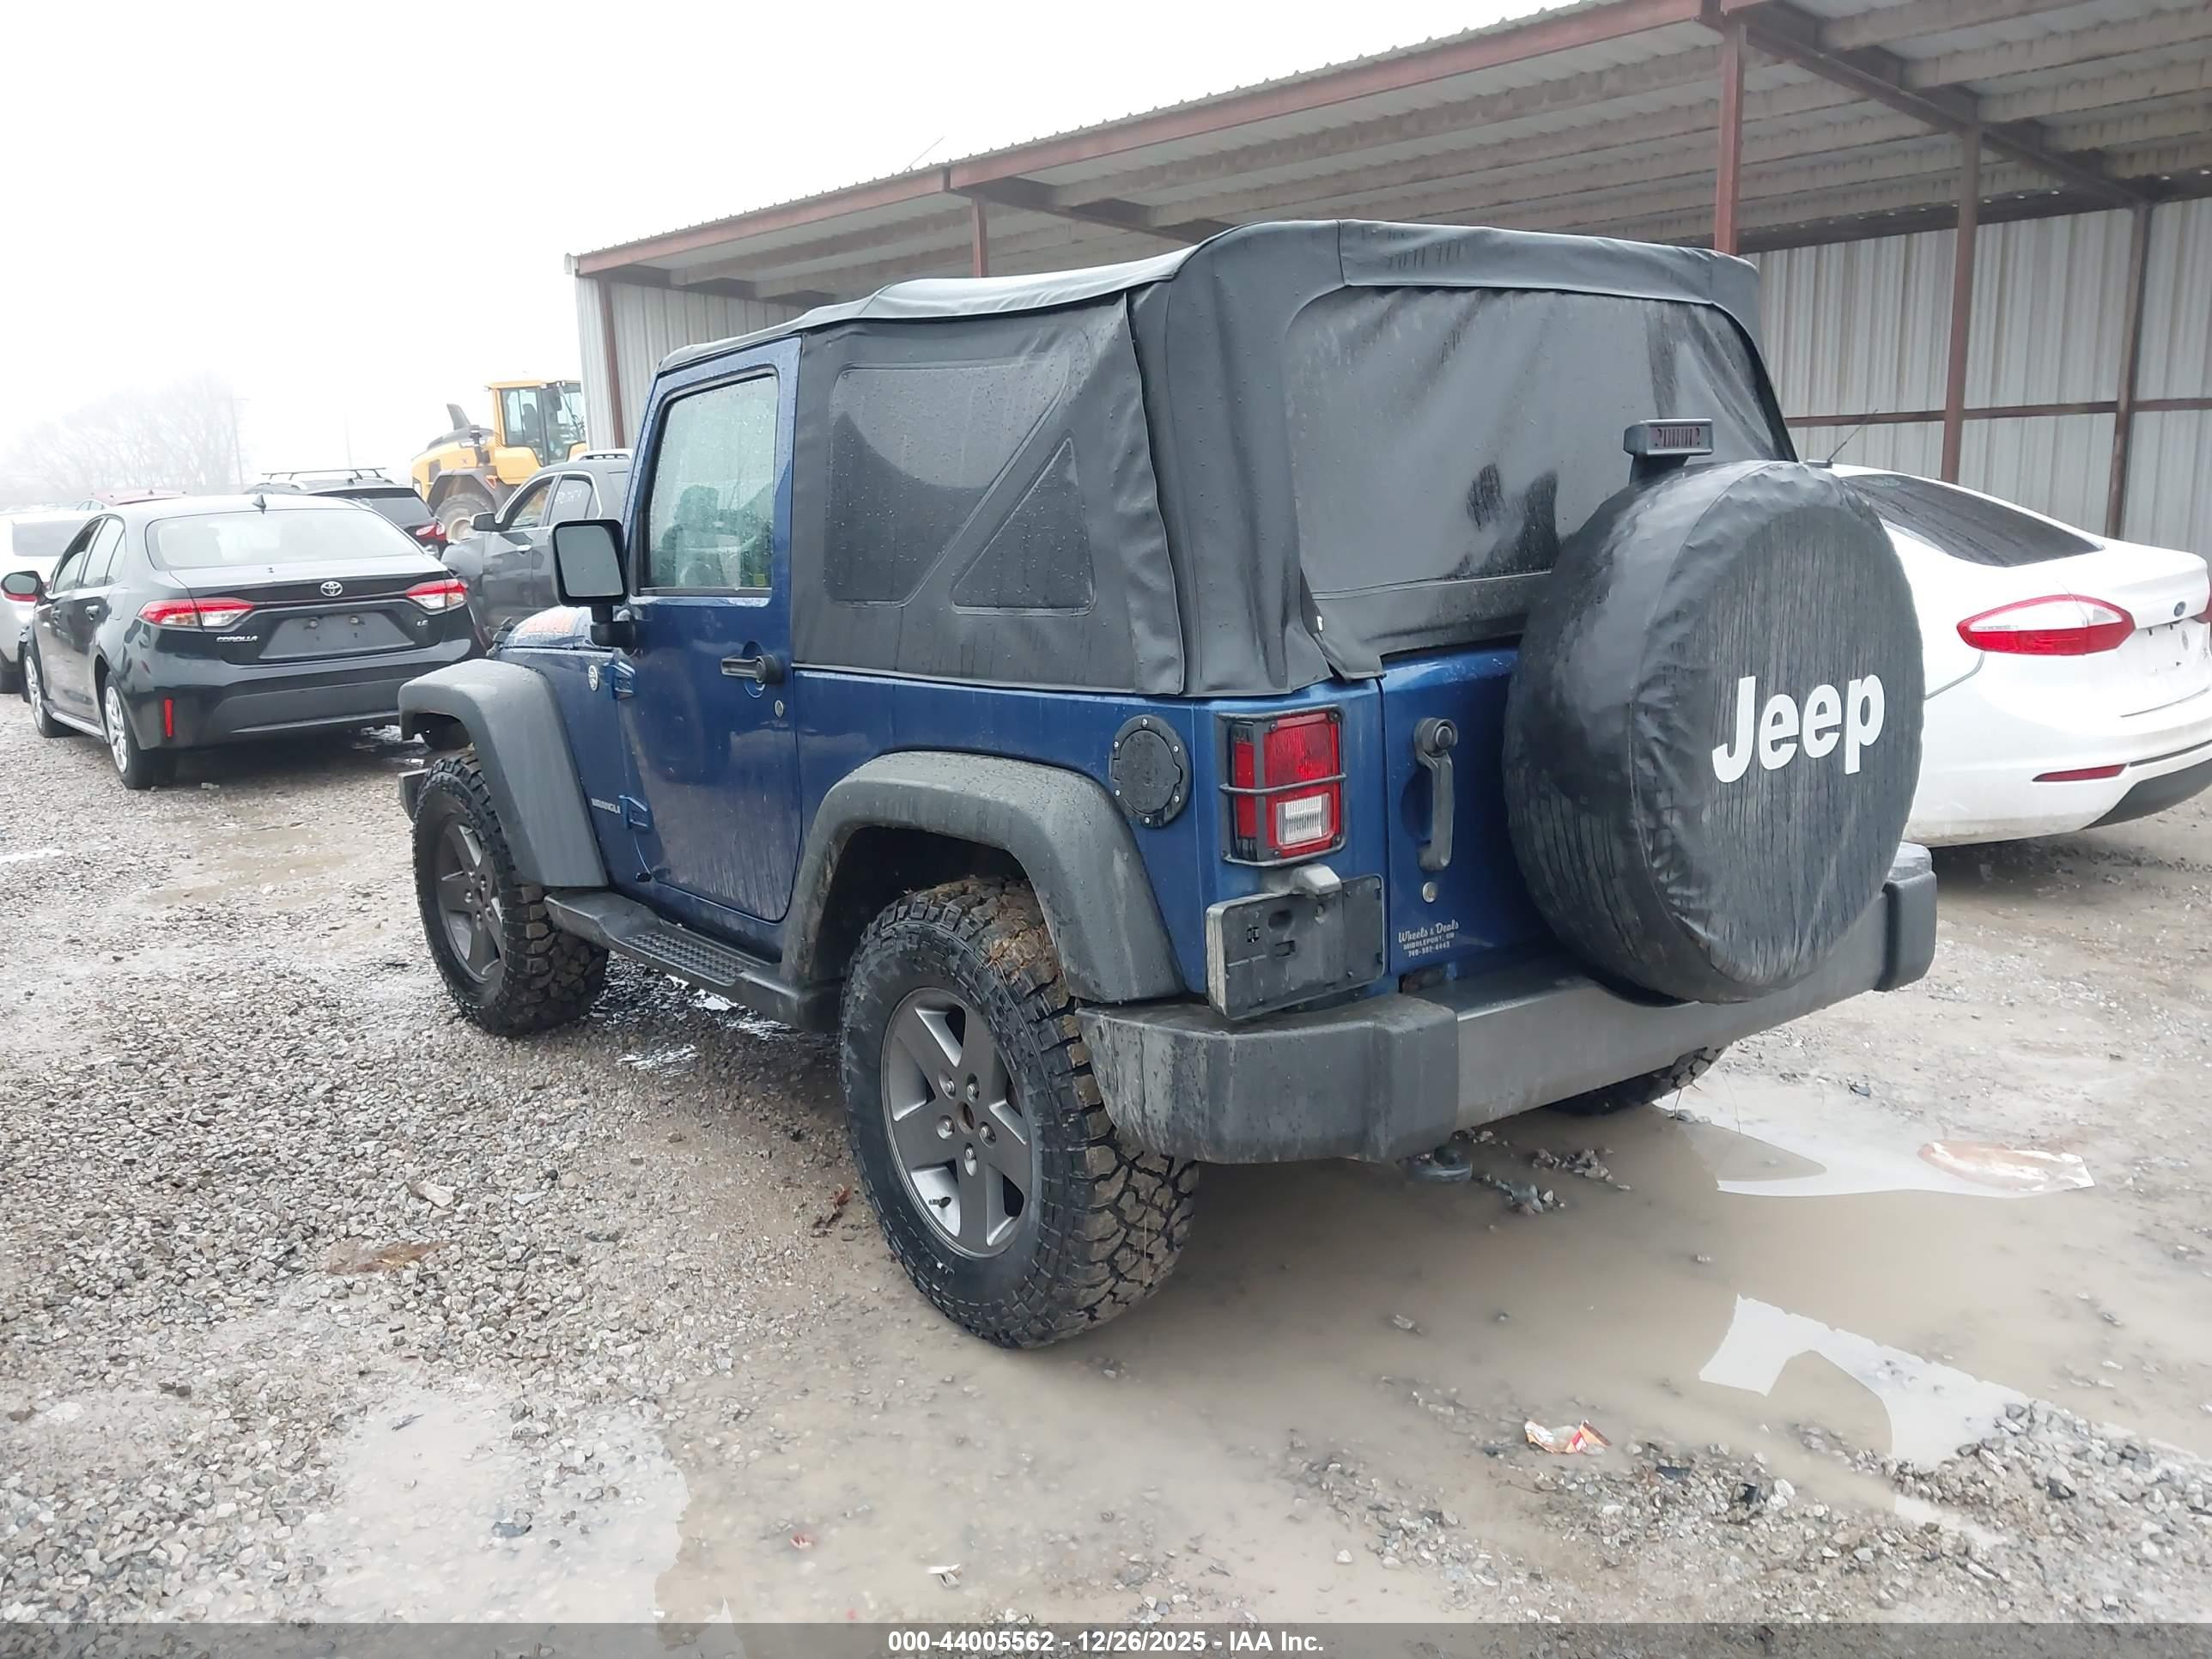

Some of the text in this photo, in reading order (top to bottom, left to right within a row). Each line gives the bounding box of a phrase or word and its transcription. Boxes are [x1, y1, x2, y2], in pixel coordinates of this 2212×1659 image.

[216, 635, 258, 643] COROLLA
[1711, 674, 1885, 783] Jeep
[1398, 919, 1459, 943] Wheels & Deals
